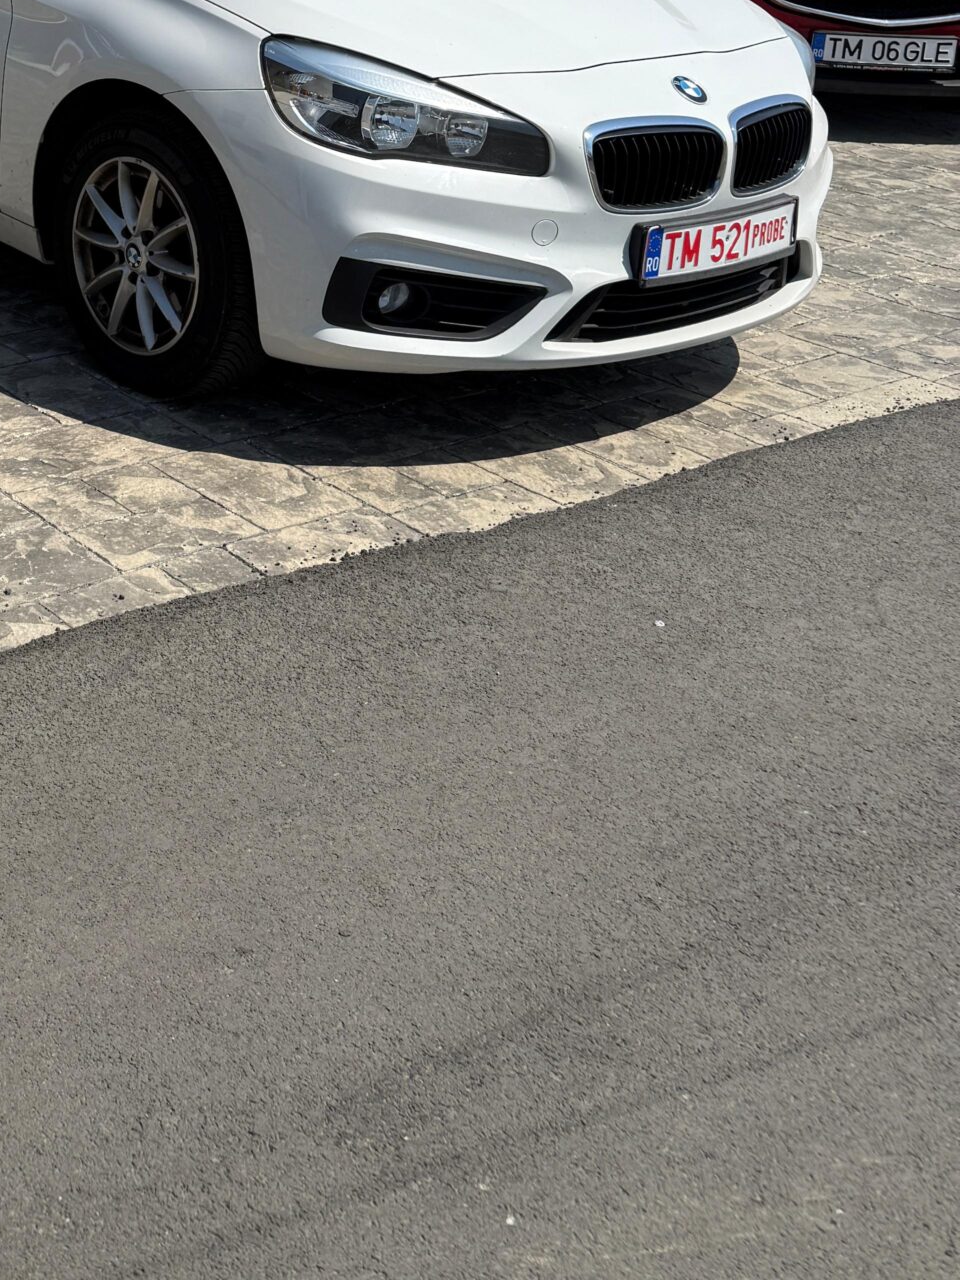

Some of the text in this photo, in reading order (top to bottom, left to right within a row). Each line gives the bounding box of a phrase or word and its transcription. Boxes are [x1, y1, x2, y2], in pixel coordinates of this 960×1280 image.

[813, 37, 954, 64] RO TM 06 GLE
[645, 216, 787, 273] RO TM 521 PROBE
